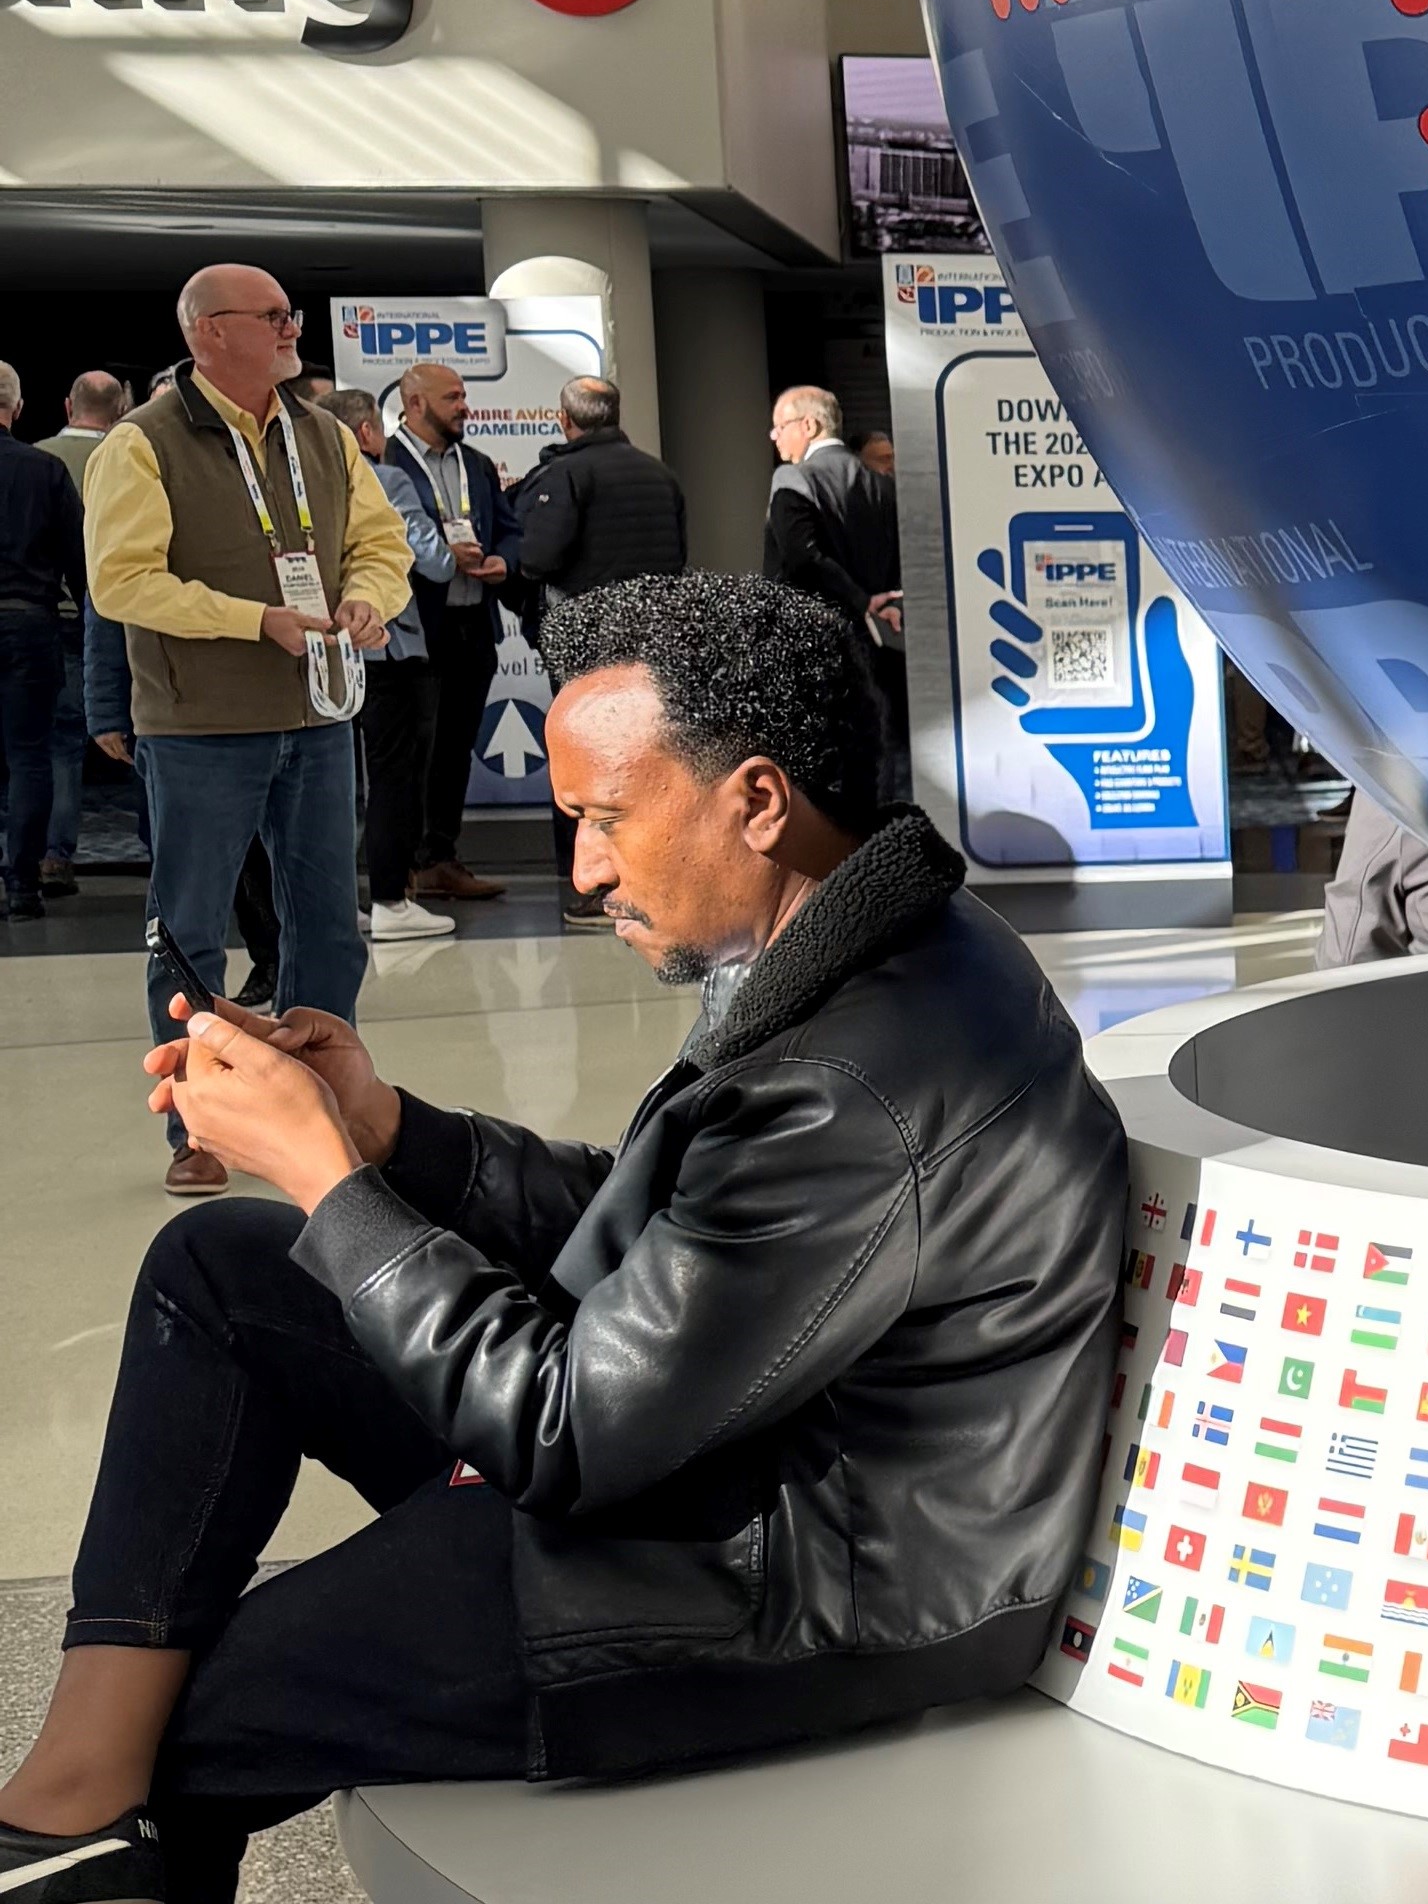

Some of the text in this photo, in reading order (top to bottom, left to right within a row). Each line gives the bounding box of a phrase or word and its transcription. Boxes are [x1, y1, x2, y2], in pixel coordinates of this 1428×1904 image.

[361, 322, 488, 355] IPPE
[997, 398, 1071, 423] DOW
[986, 431, 1089, 456] THE 202
[1013, 463, 1084, 489] EXPO
[1044, 562, 1117, 582] IPPE
